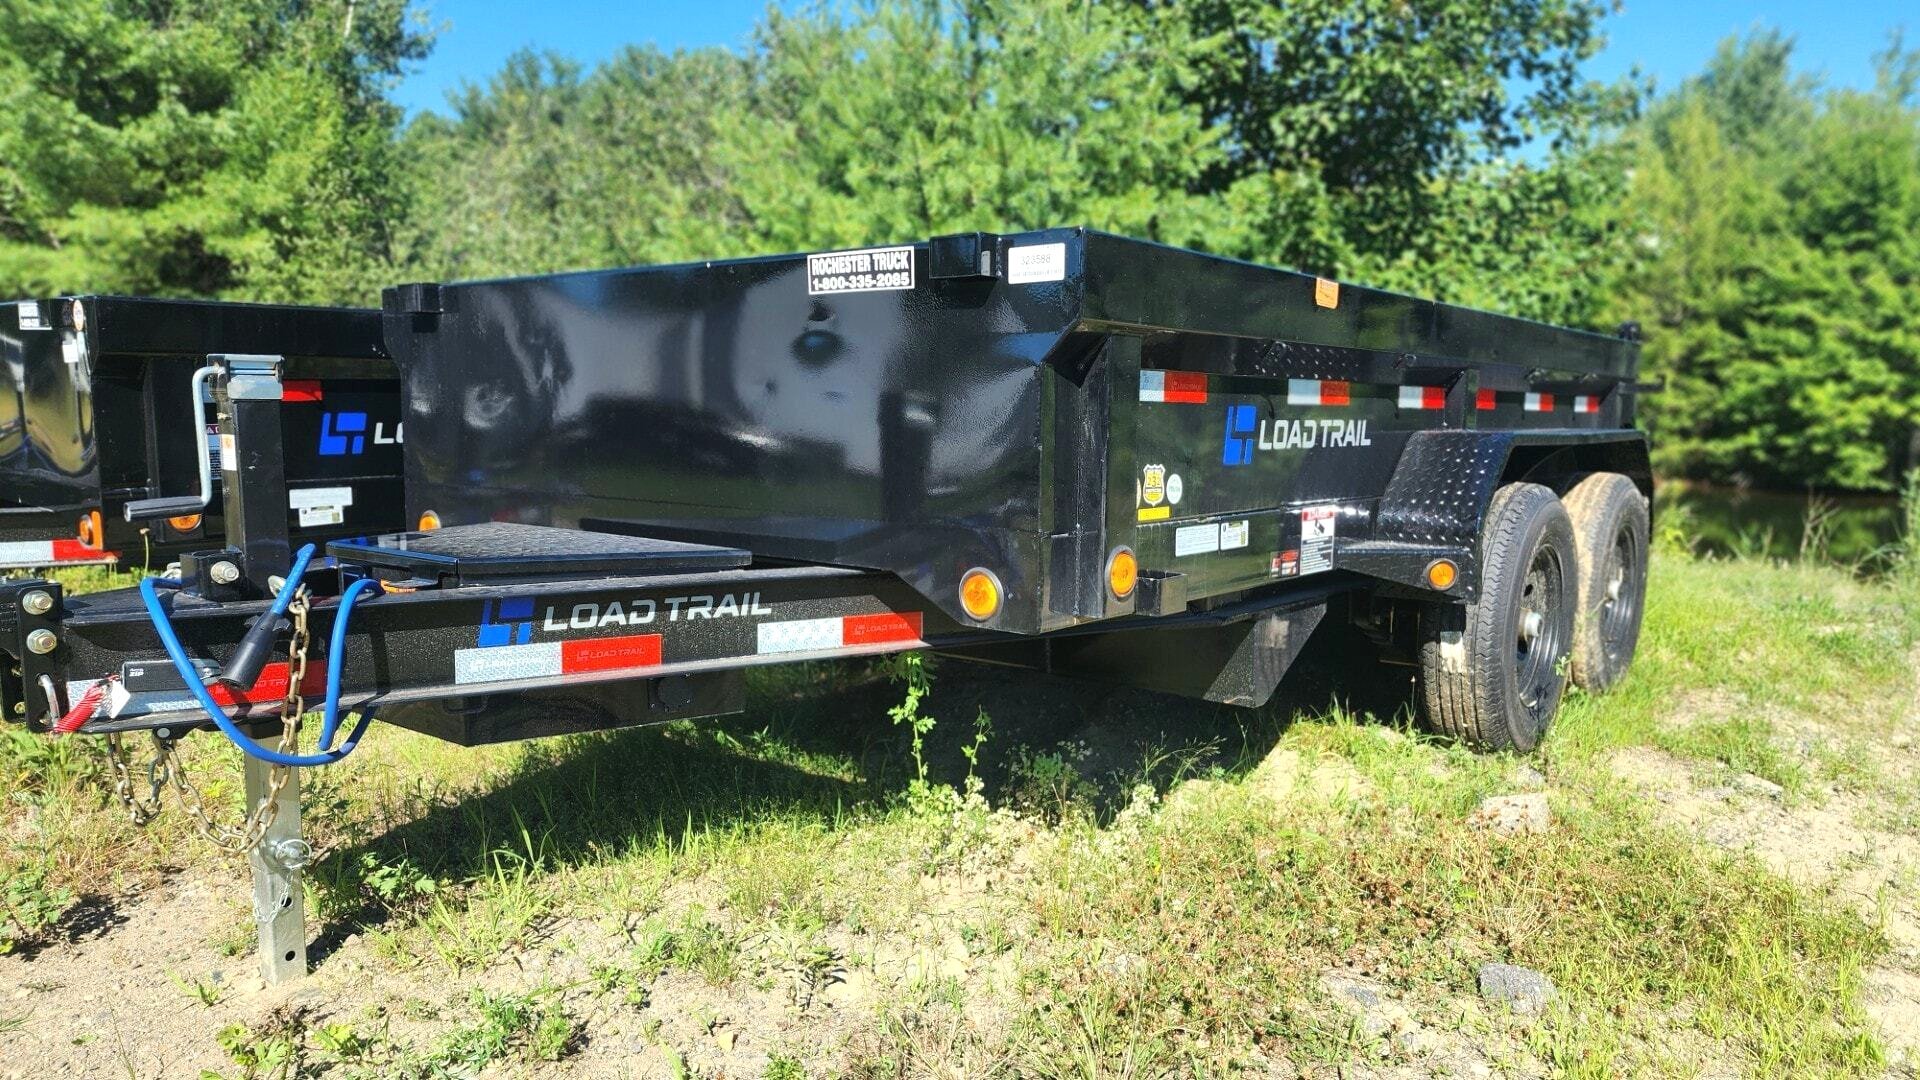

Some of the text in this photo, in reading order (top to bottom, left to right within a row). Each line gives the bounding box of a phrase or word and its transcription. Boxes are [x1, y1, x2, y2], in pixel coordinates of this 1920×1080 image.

[811, 251, 910, 276] ROCHESTER TRUCK
[812, 272, 910, 291] 1-800-335-2085
[1258, 419, 1317, 450] LOAD
[1319, 419, 1371, 448] TRAIL
[543, 599, 656, 632] LOAD
[664, 592, 772, 622] TRAIL
[590, 649, 618, 659] LOAD
